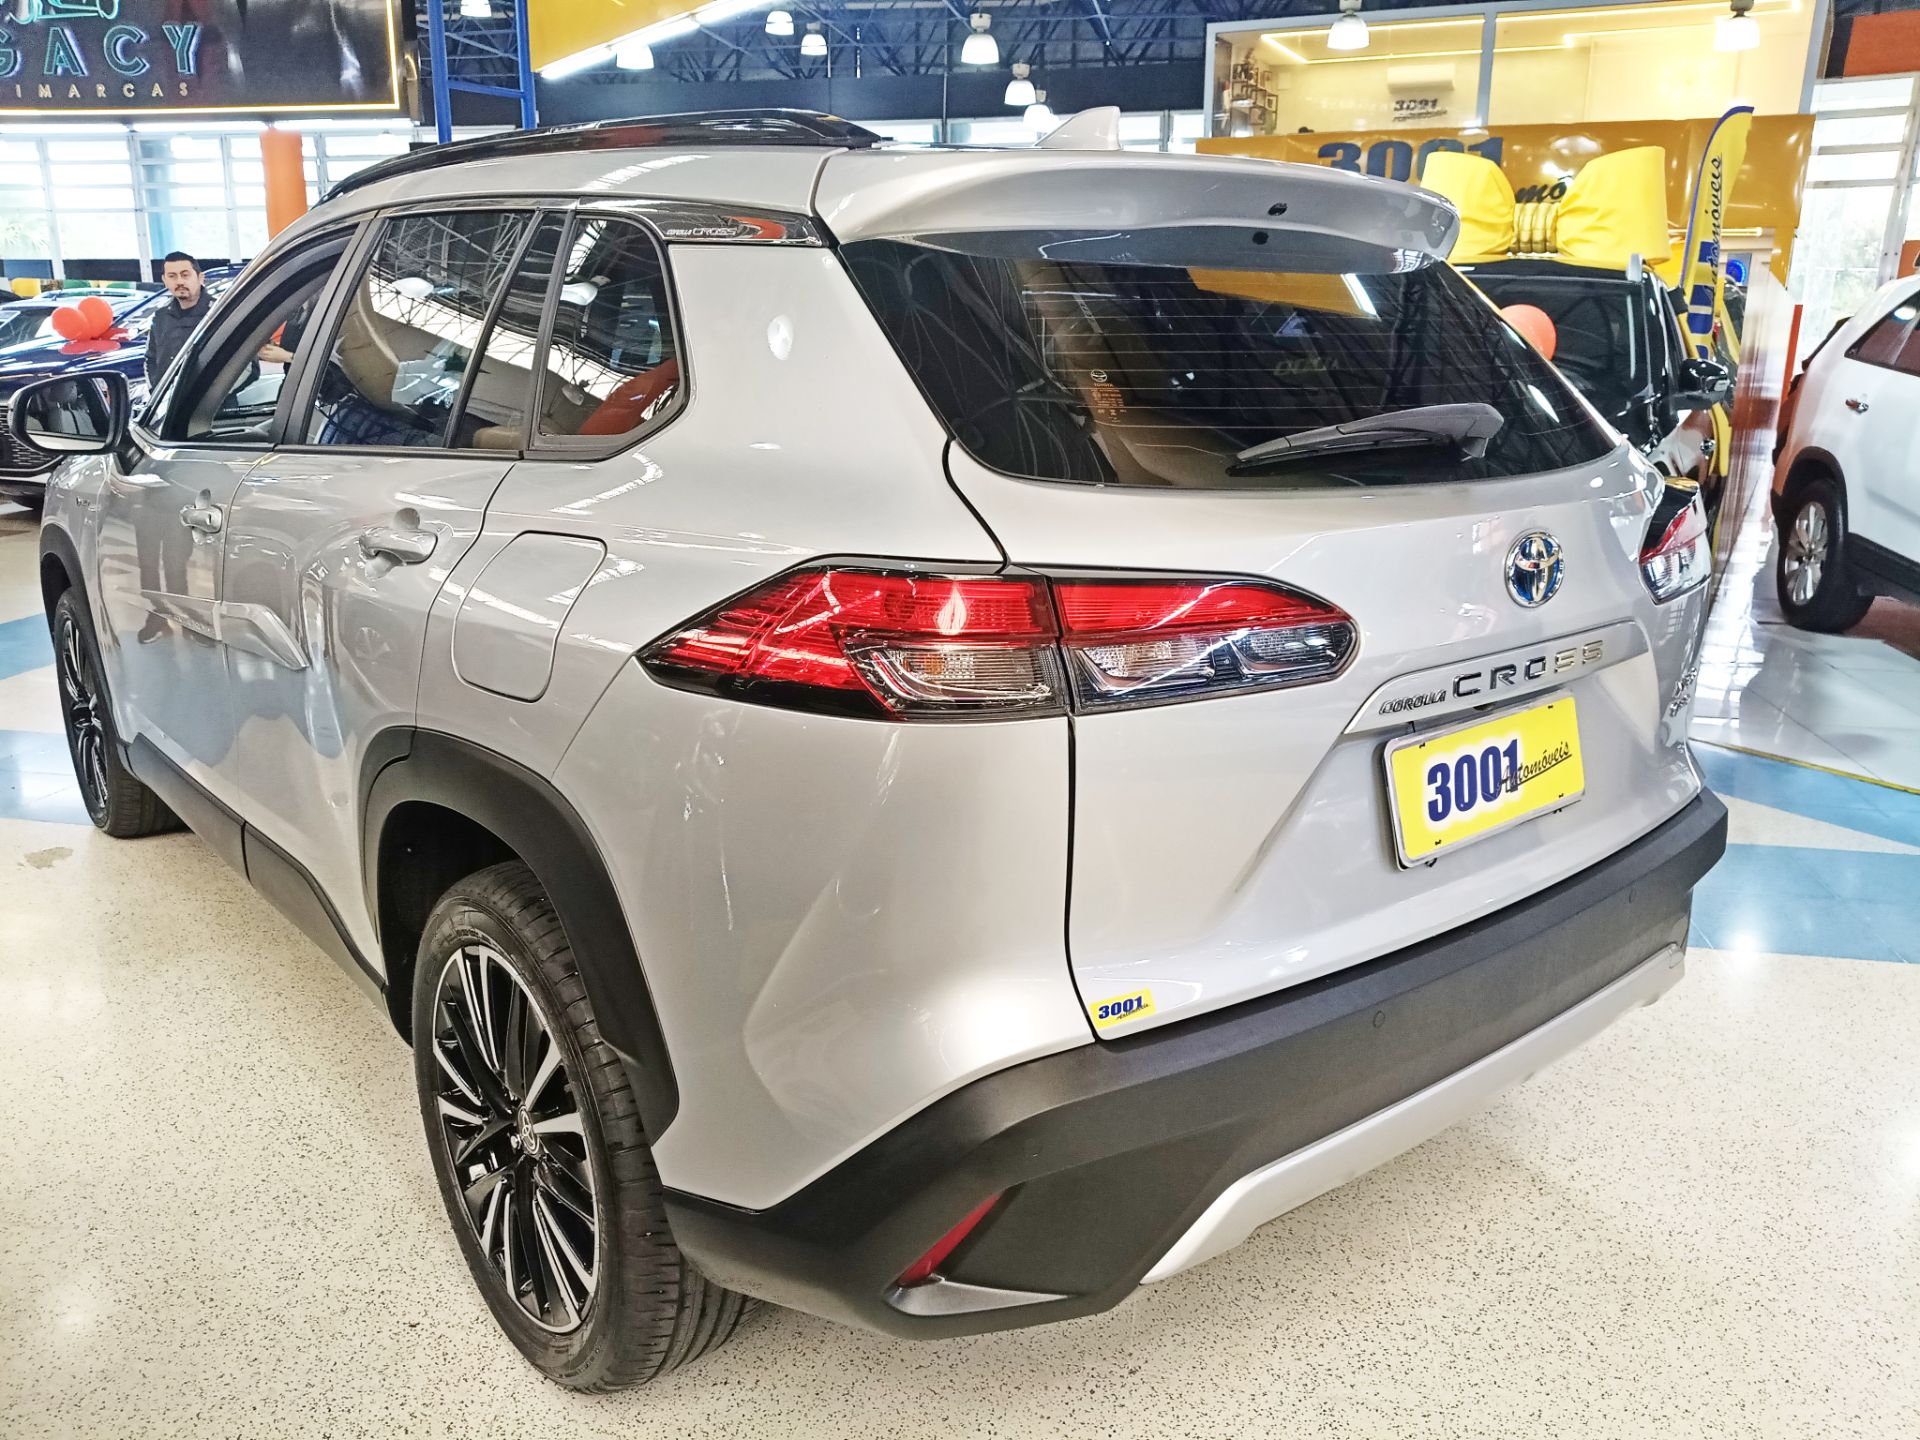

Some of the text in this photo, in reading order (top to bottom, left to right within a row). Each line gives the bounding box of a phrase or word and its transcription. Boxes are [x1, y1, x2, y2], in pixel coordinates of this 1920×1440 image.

[693, 227, 738, 236] CROSS
[1379, 640, 1603, 715] COROLLA CROSS
[1427, 738, 1572, 822] 3001 Automóveis
[1098, 995, 1142, 1019] 3001
